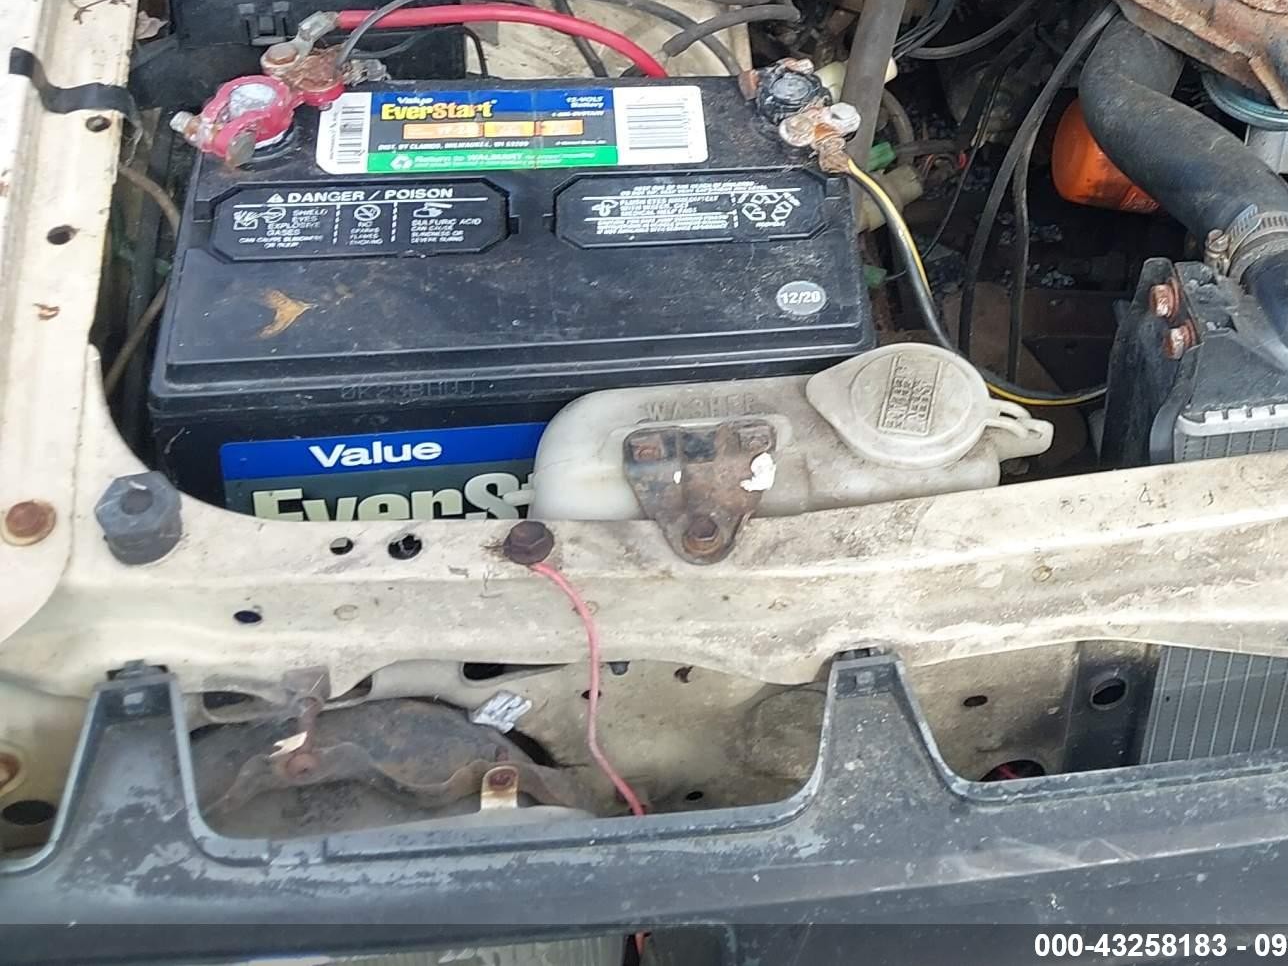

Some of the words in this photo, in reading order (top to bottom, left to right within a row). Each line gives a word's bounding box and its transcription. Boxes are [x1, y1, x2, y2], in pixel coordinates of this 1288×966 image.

[381, 101, 493, 121] EverStart
[288, 190, 365, 203] DANGER
[384, 187, 454, 199] POISON
[459, 217, 482, 225] ACID
[780, 290, 821, 305] 12/20
[308, 441, 442, 468] Value
[253, 472, 535, 521] EverS
